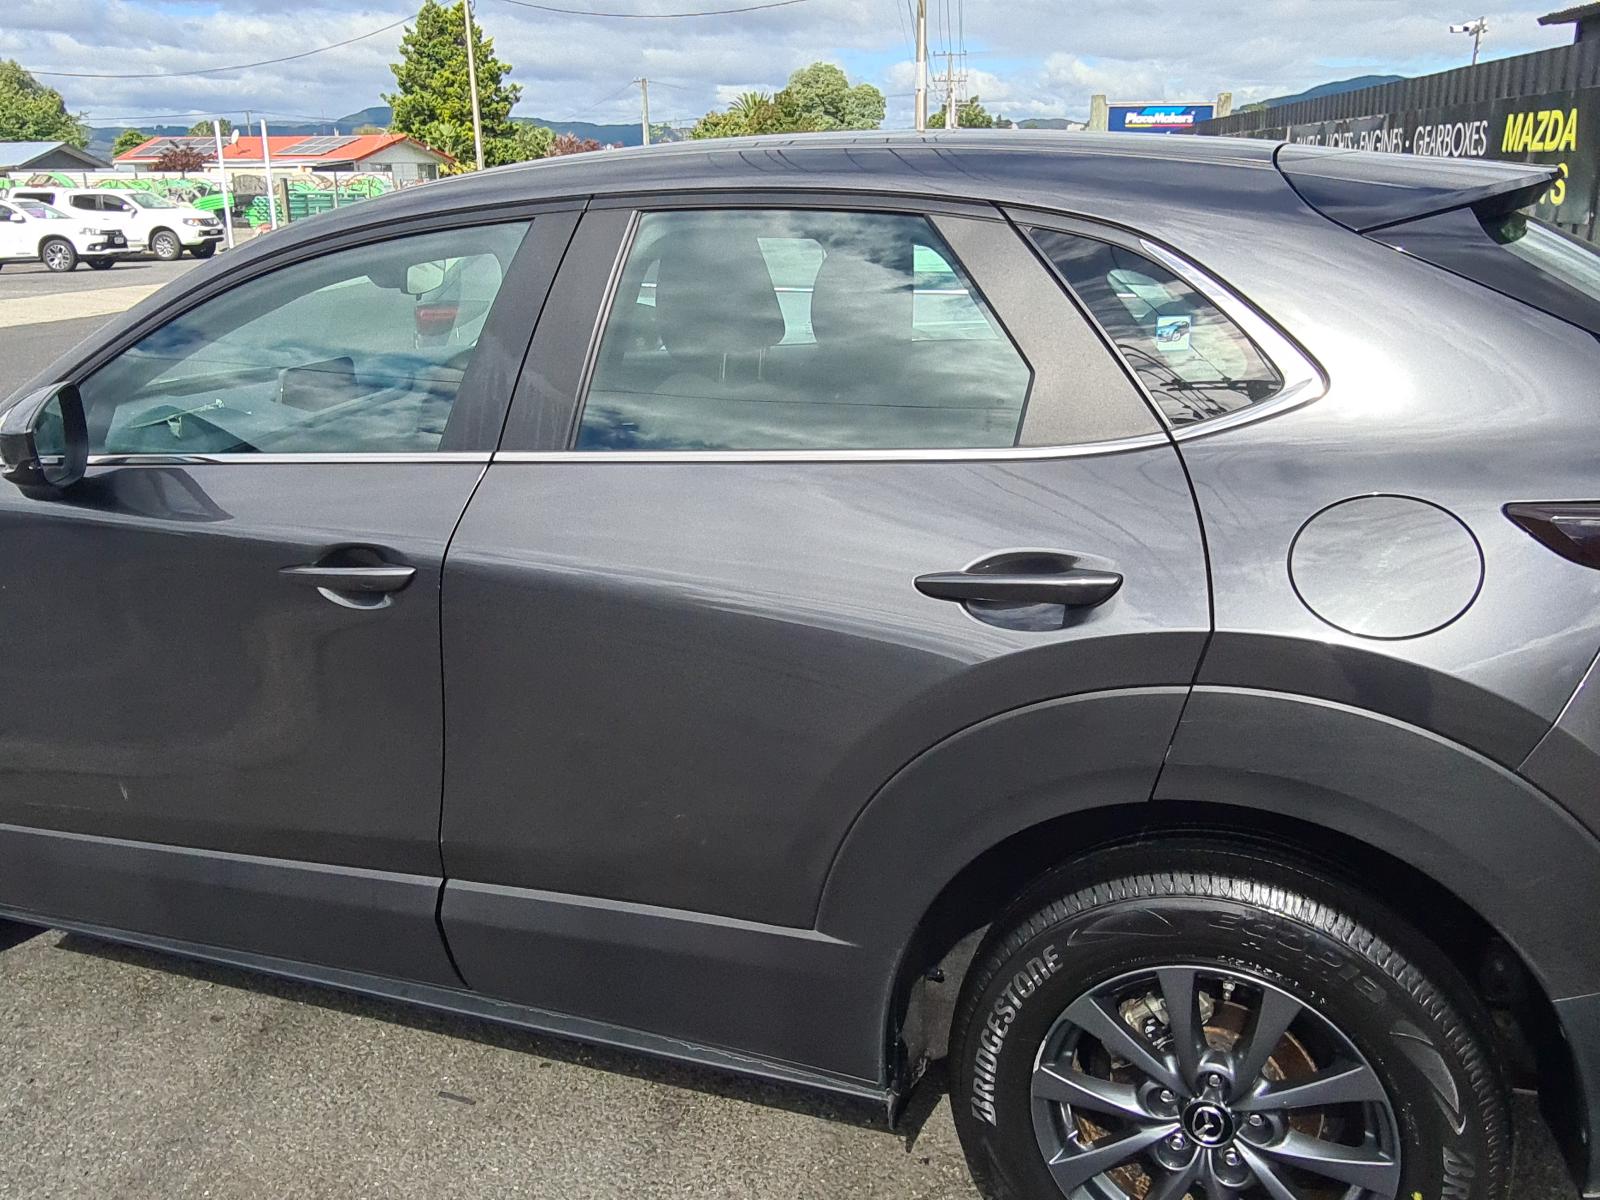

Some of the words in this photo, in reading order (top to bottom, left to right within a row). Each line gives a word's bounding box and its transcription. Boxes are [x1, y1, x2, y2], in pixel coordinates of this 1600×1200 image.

[1413, 120, 1488, 157] GEARBOXES
[1501, 108, 1578, 153] MAZDA
[971, 944, 1064, 1127] BRIDGESTONE
